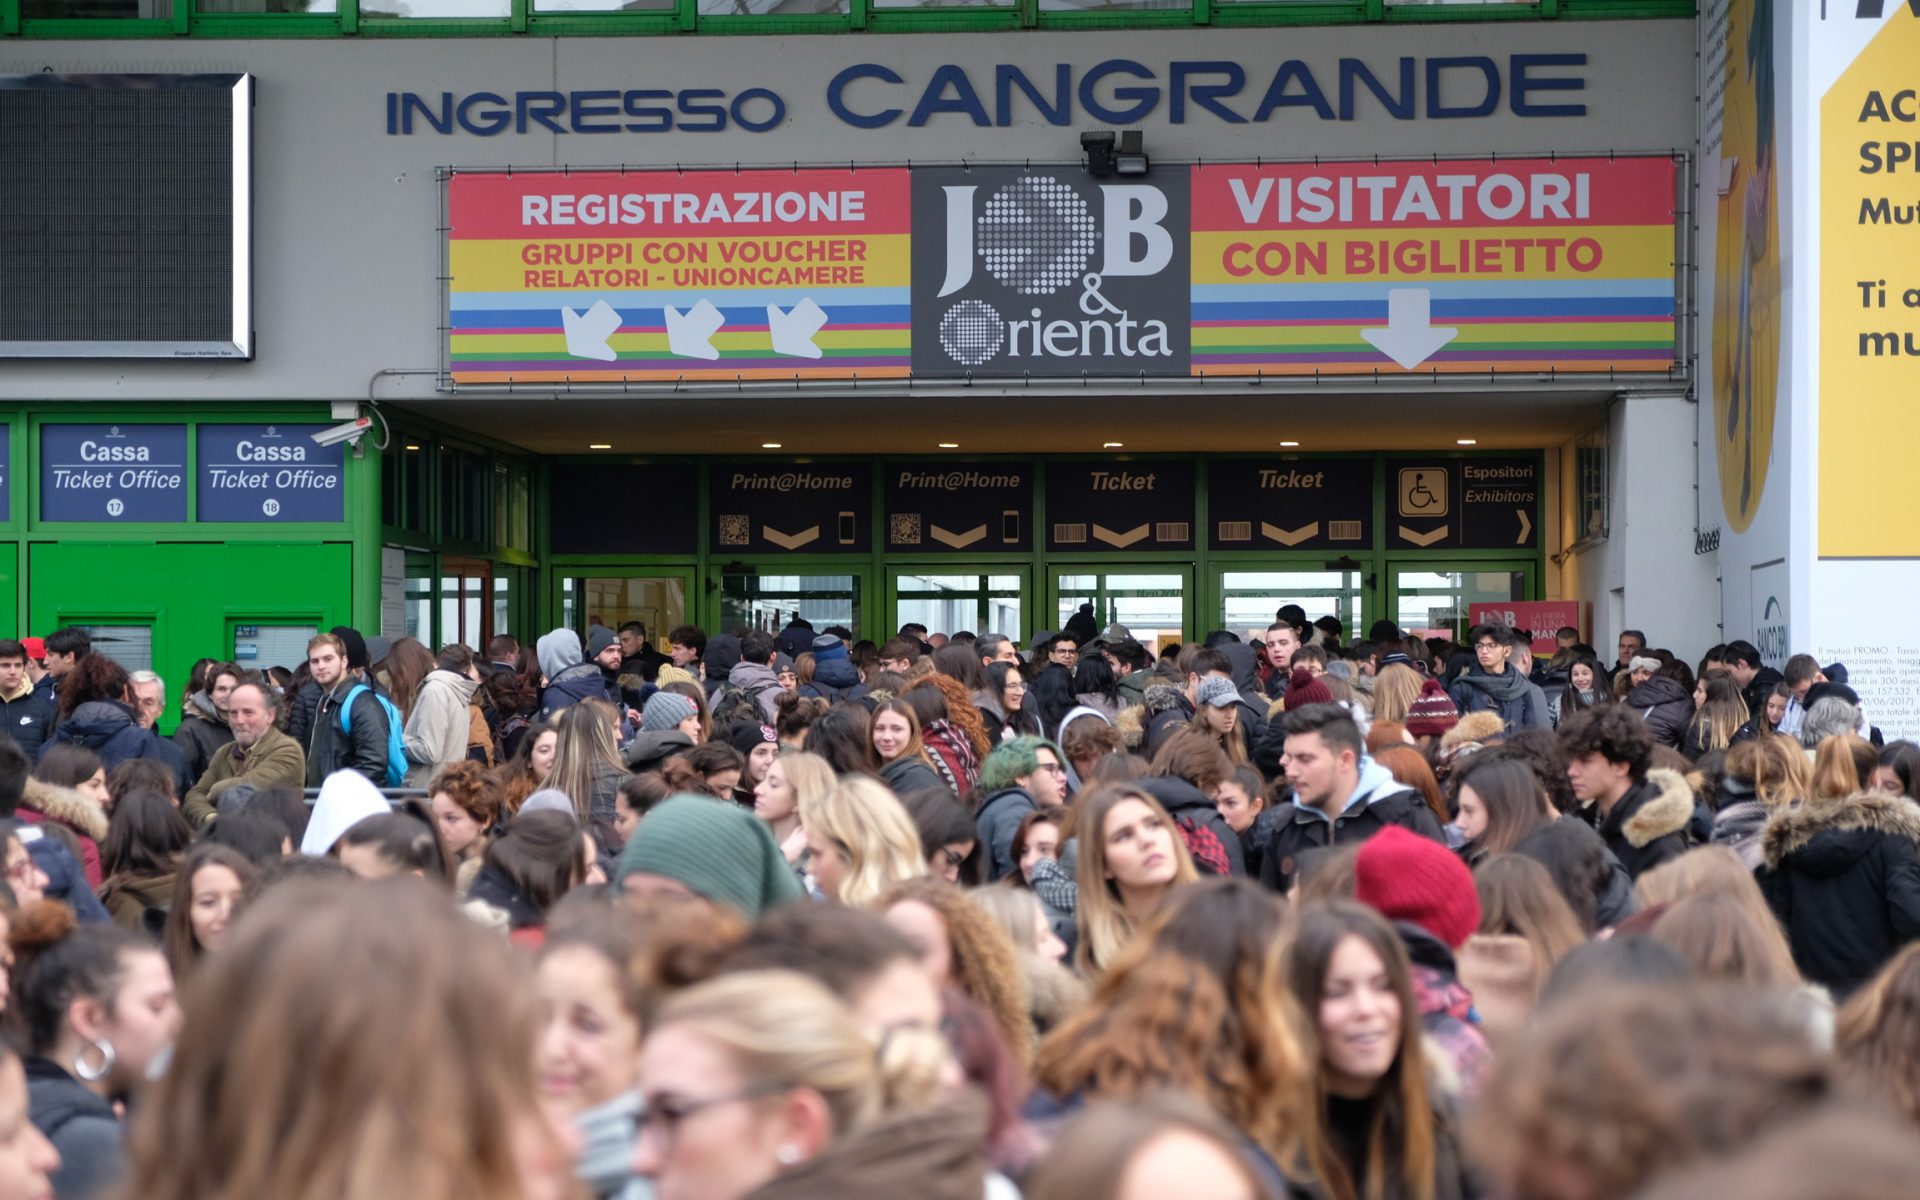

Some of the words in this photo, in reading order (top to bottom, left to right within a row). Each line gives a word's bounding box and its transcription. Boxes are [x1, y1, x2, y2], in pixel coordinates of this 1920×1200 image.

[386, 87, 786, 136] INGRESSO
[826, 53, 1587, 129] CANGRANDE
[1857, 89, 1920, 122] AC
[1858, 141, 1920, 174] SP
[521, 190, 866, 226] REGISTRAZIONE
[1229, 173, 1591, 224] VISITATORI
[521, 243, 633, 266] GRUPPI
[643, 242, 709, 264] CON
[720, 240, 867, 263] VOUCHER
[1222, 241, 1329, 276] CON
[1345, 237, 1603, 274] BIGLIETTO
[523, 268, 648, 288] RELATORI
[673, 265, 865, 286] UNIONCAMERE
[1079, 272, 1125, 316] &
[1857, 279, 1886, 308] Ti
[80, 440, 149, 461] Cassa
[236, 440, 306, 461] Cassa
[53, 470, 112, 488] Ticket
[119, 470, 181, 488] Office
[209, 470, 268, 488] Ticket
[275, 470, 337, 488] Office
[899, 472, 1020, 491] Print@Home
[1090, 471, 1155, 491] Ticket
[1259, 470, 1324, 489] Ticket
[1464, 465, 1533, 480] Espositori
[731, 473, 853, 492] Print@Home
[1464, 490, 1534, 503] Exhibitors
[109, 502, 121, 513] 17
[265, 502, 277, 513] 18
[1531, 620, 1540, 629] IN
[1544, 620, 1566, 628] UNA
[1532, 630, 1557, 639] MAN
[1854, 646, 1889, 654] PROMO
[1897, 646, 1919, 654] Tasso
[1818, 656, 1831, 665] del
[1876, 666, 1896, 675] delle
[1849, 676, 1867, 685] abili
[1880, 677, 1898, 685] 300
[1863, 697, 1914, 706] 0/06/2017)
[1887, 707, 1910, 715] totale
